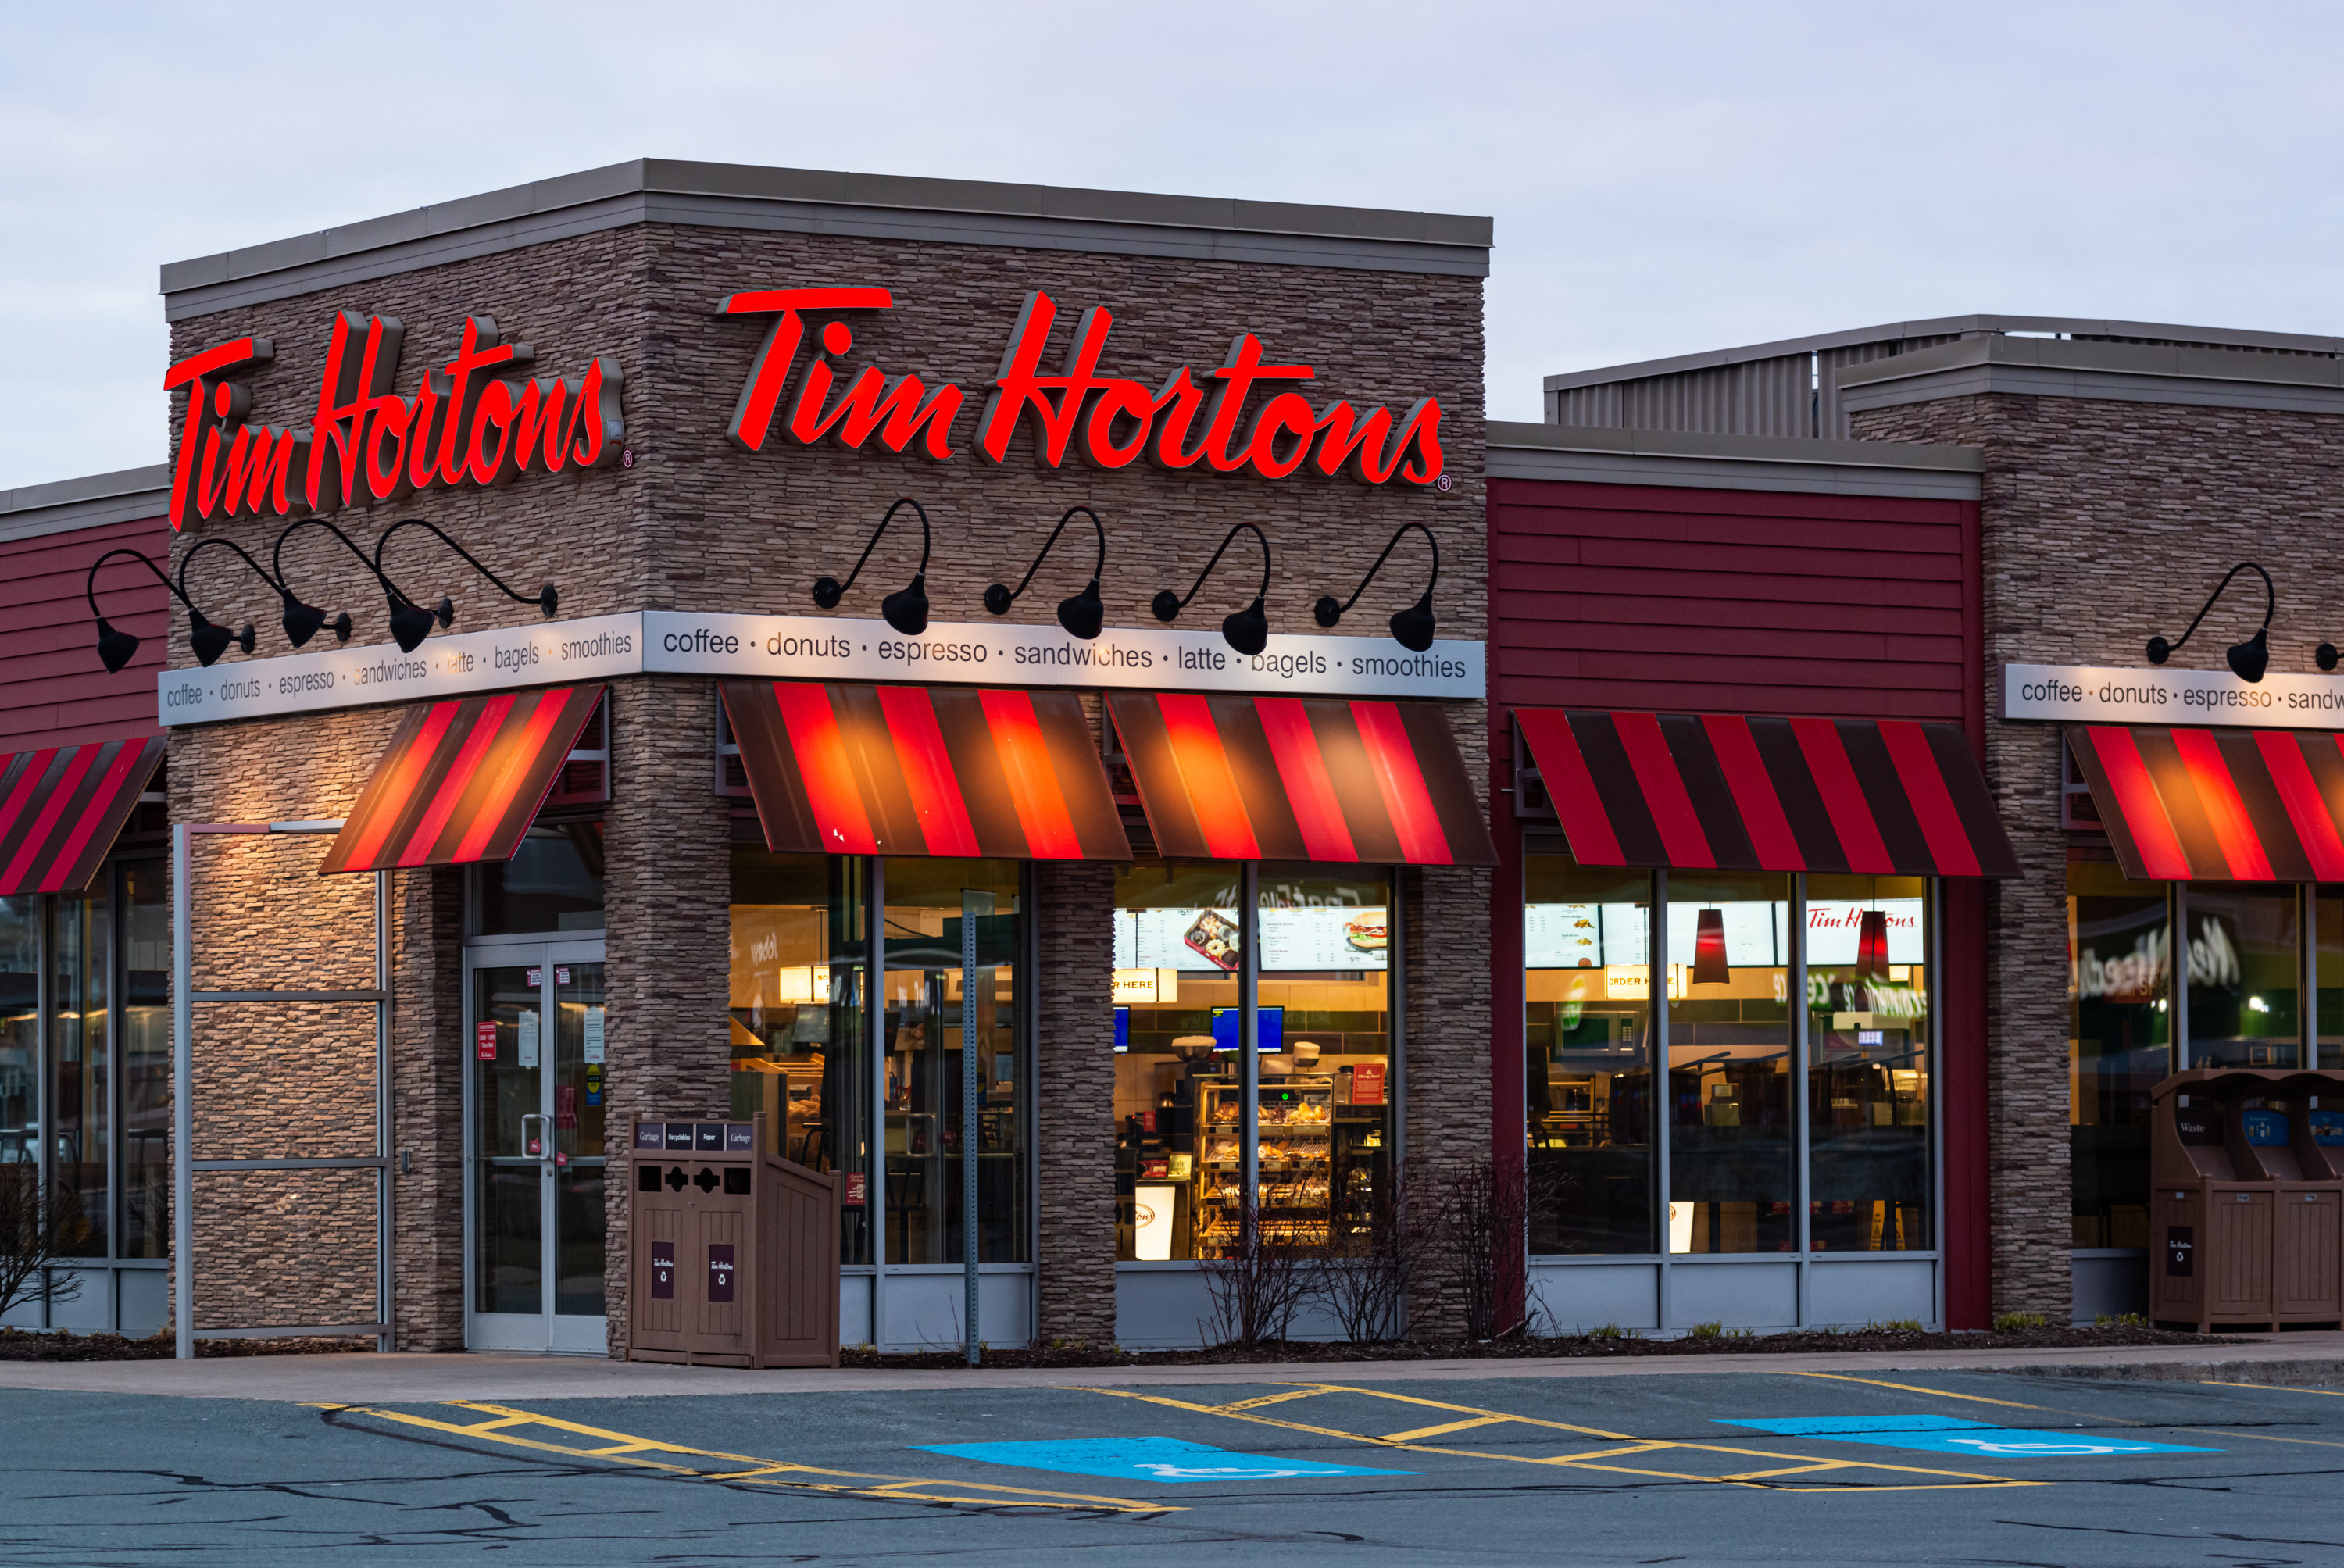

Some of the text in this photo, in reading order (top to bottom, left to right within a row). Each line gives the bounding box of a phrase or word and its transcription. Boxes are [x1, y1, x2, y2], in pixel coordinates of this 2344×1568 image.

[726, 288, 1444, 486] Tim Hortons
[163, 309, 603, 532] Tim Hortons
[663, 627, 1466, 679] coffee donuts espresso sandwiches latte bagels smoothies
[167, 631, 631, 708] coffee donuts espresso sandwiches latte bagels smoothies
[2022, 679, 2083, 702] coffee
[2099, 681, 2167, 704] donuts
[2183, 687, 2272, 712] espresso
[1807, 908, 1841, 929] Tim
[1609, 977, 1641, 986] ORDER
[2181, 1123, 2205, 1133] Waste
[640, 1131, 659, 1142] Garbage
[668, 1133, 691, 1141] Recyclables
[703, 1133, 716, 1141] Paper
[731, 1133, 751, 1144] Garbage
